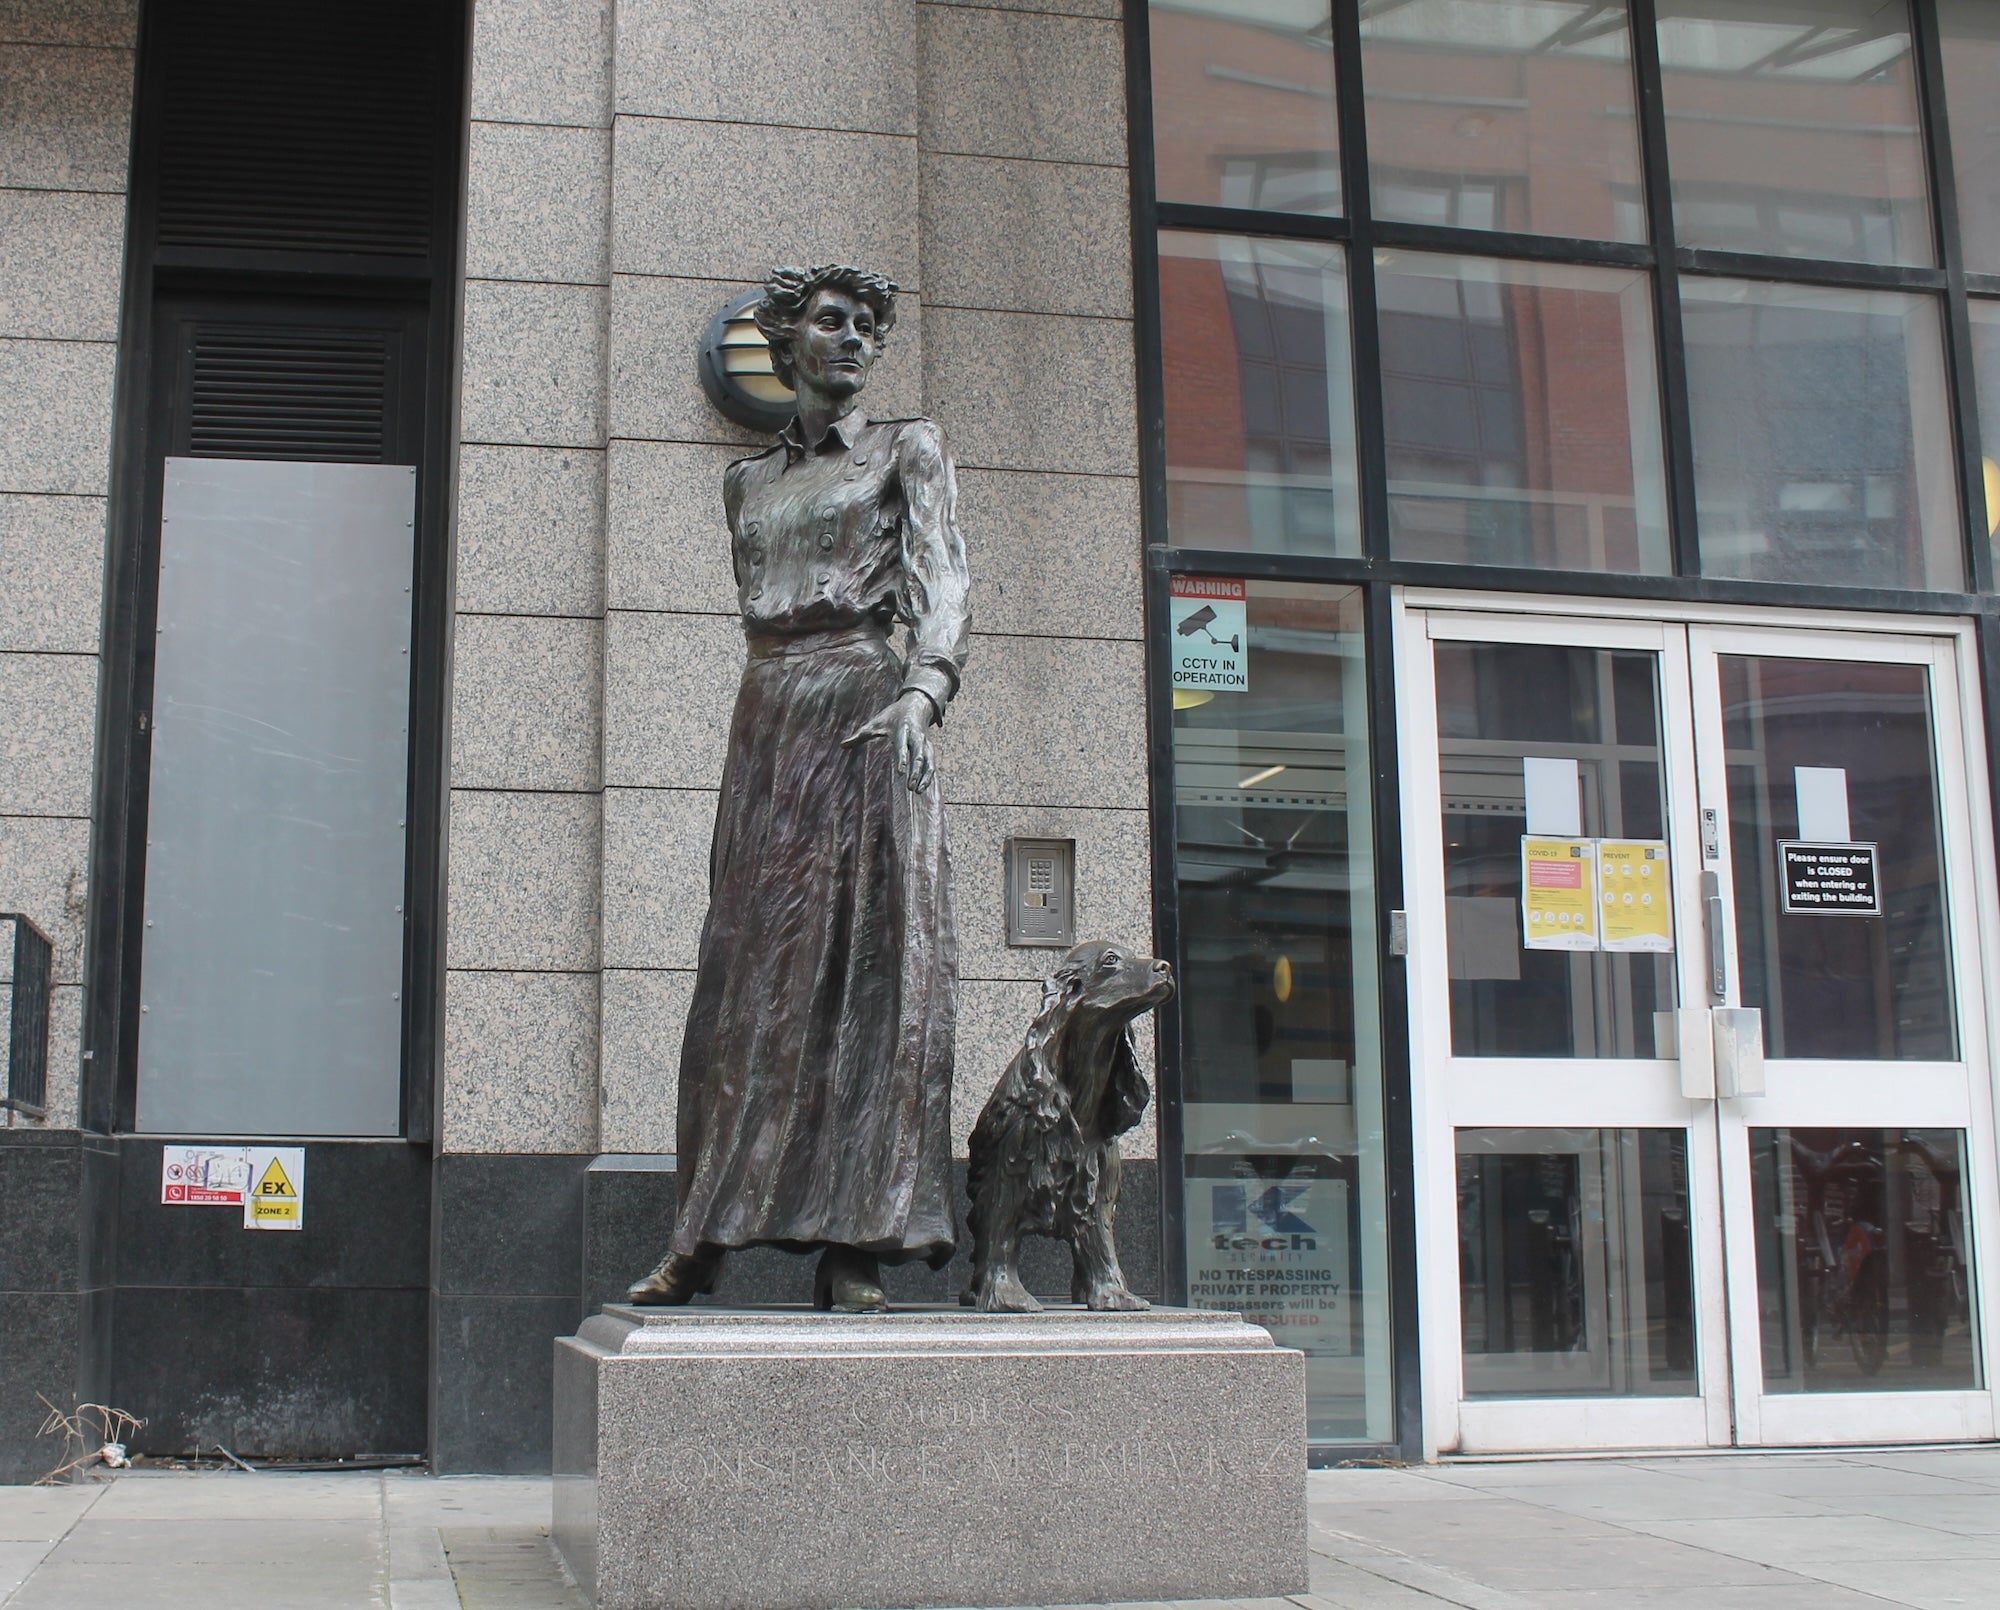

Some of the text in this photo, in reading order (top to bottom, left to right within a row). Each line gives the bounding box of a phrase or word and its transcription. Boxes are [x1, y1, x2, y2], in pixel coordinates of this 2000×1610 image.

[1172, 580, 1242, 596] WARNING
[1182, 657, 1235, 670] CCTV IN
[1173, 671, 1245, 685] OPERATION
[1603, 852, 1630, 860] PREVENT
[1788, 853, 1870, 865] Please ensure door
[1807, 866, 1853, 877] is CLOSED
[1795, 880, 1819, 888] when
[1820, 880, 1856, 891] entering
[1791, 892, 1873, 905] exiting the building
[262, 1182, 286, 1195] EX
[1211, 1234, 1316, 1250] tech
[1231, 1253, 1303, 1262] SECURITY
[1200, 1270, 1331, 1281] NO TRESPASSING
[1191, 1284, 1340, 1296] PRIVATE PROPERTY
[1194, 1299, 1336, 1312] Trespassers will be
[1243, 1314, 1319, 1326] SECUTED
[633, 1446, 951, 1489] CONSTANCE
